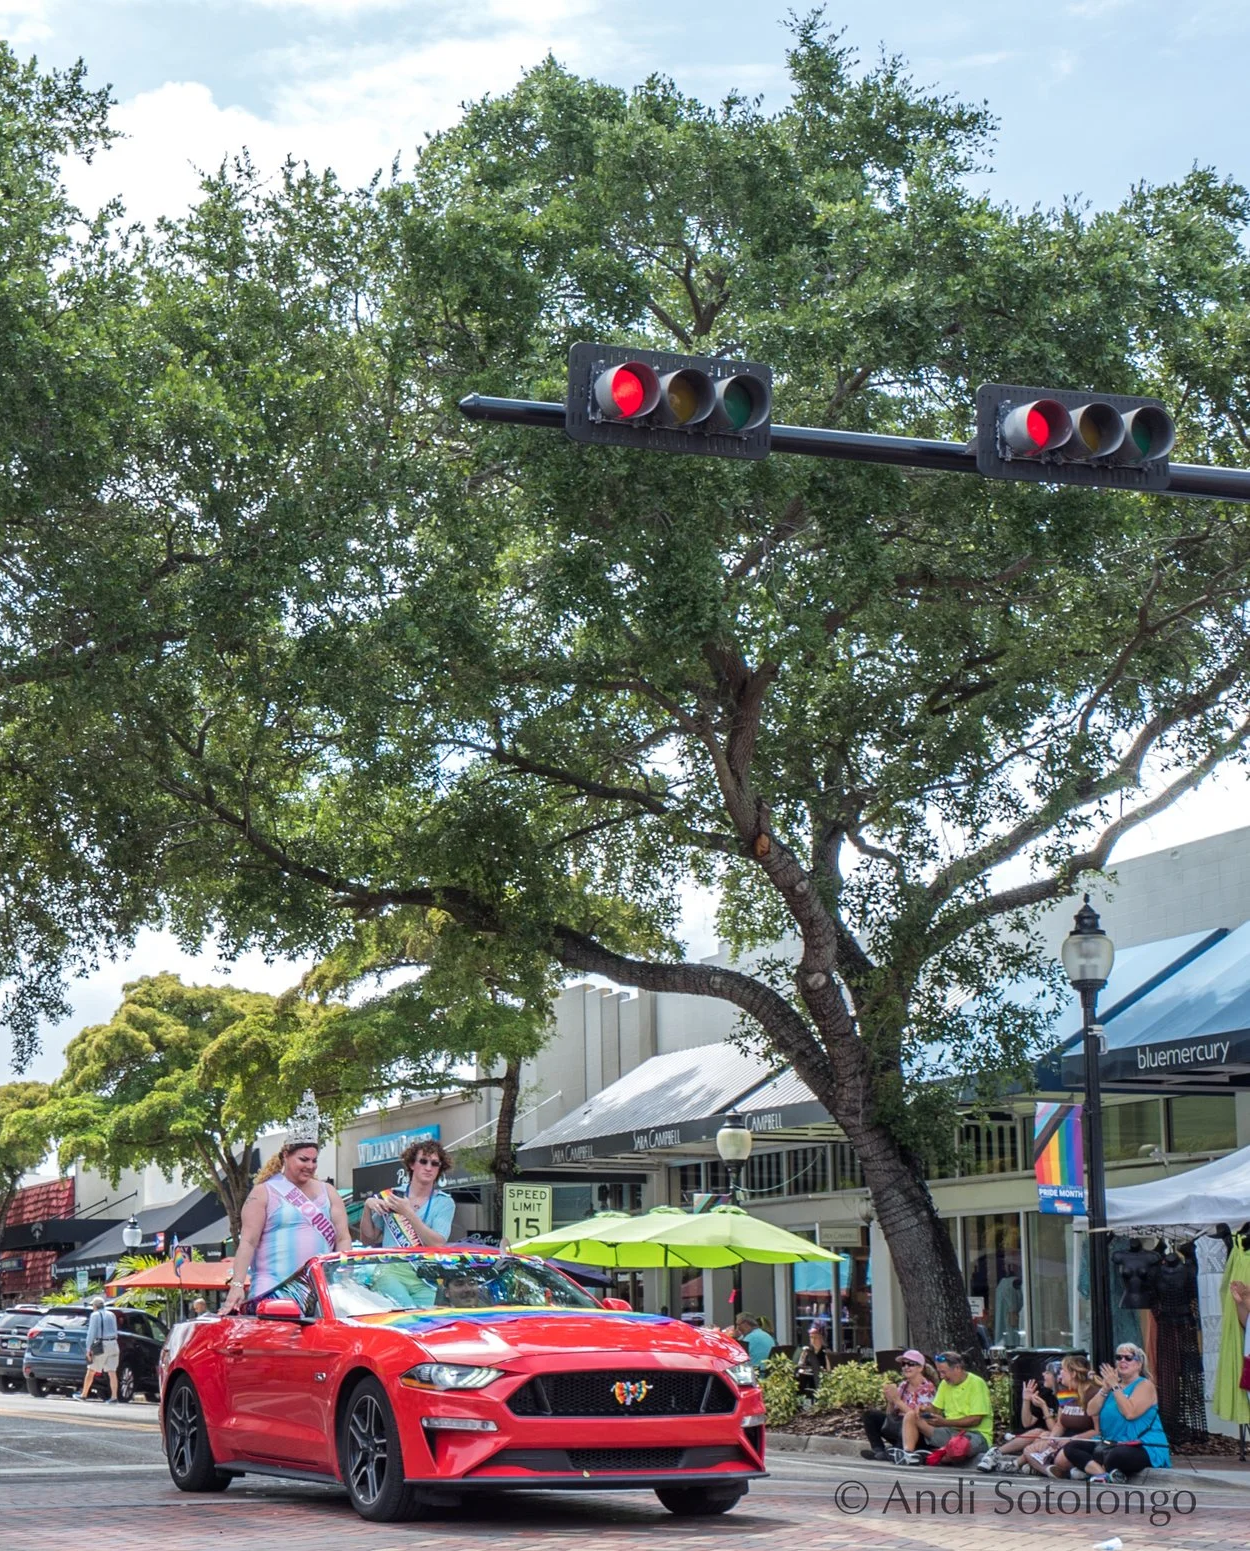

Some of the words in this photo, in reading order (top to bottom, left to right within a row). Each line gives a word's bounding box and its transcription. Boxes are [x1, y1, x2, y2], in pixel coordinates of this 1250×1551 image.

[1137, 1041, 1230, 1069] bluemercury
[508, 1188, 547, 1200] SPEED
[1038, 1188, 1058, 1197] PRIDE
[1059, 1189, 1083, 1198] MONTH
[512, 1202, 542, 1212] LIMIT
[513, 1217, 540, 1239] 15
